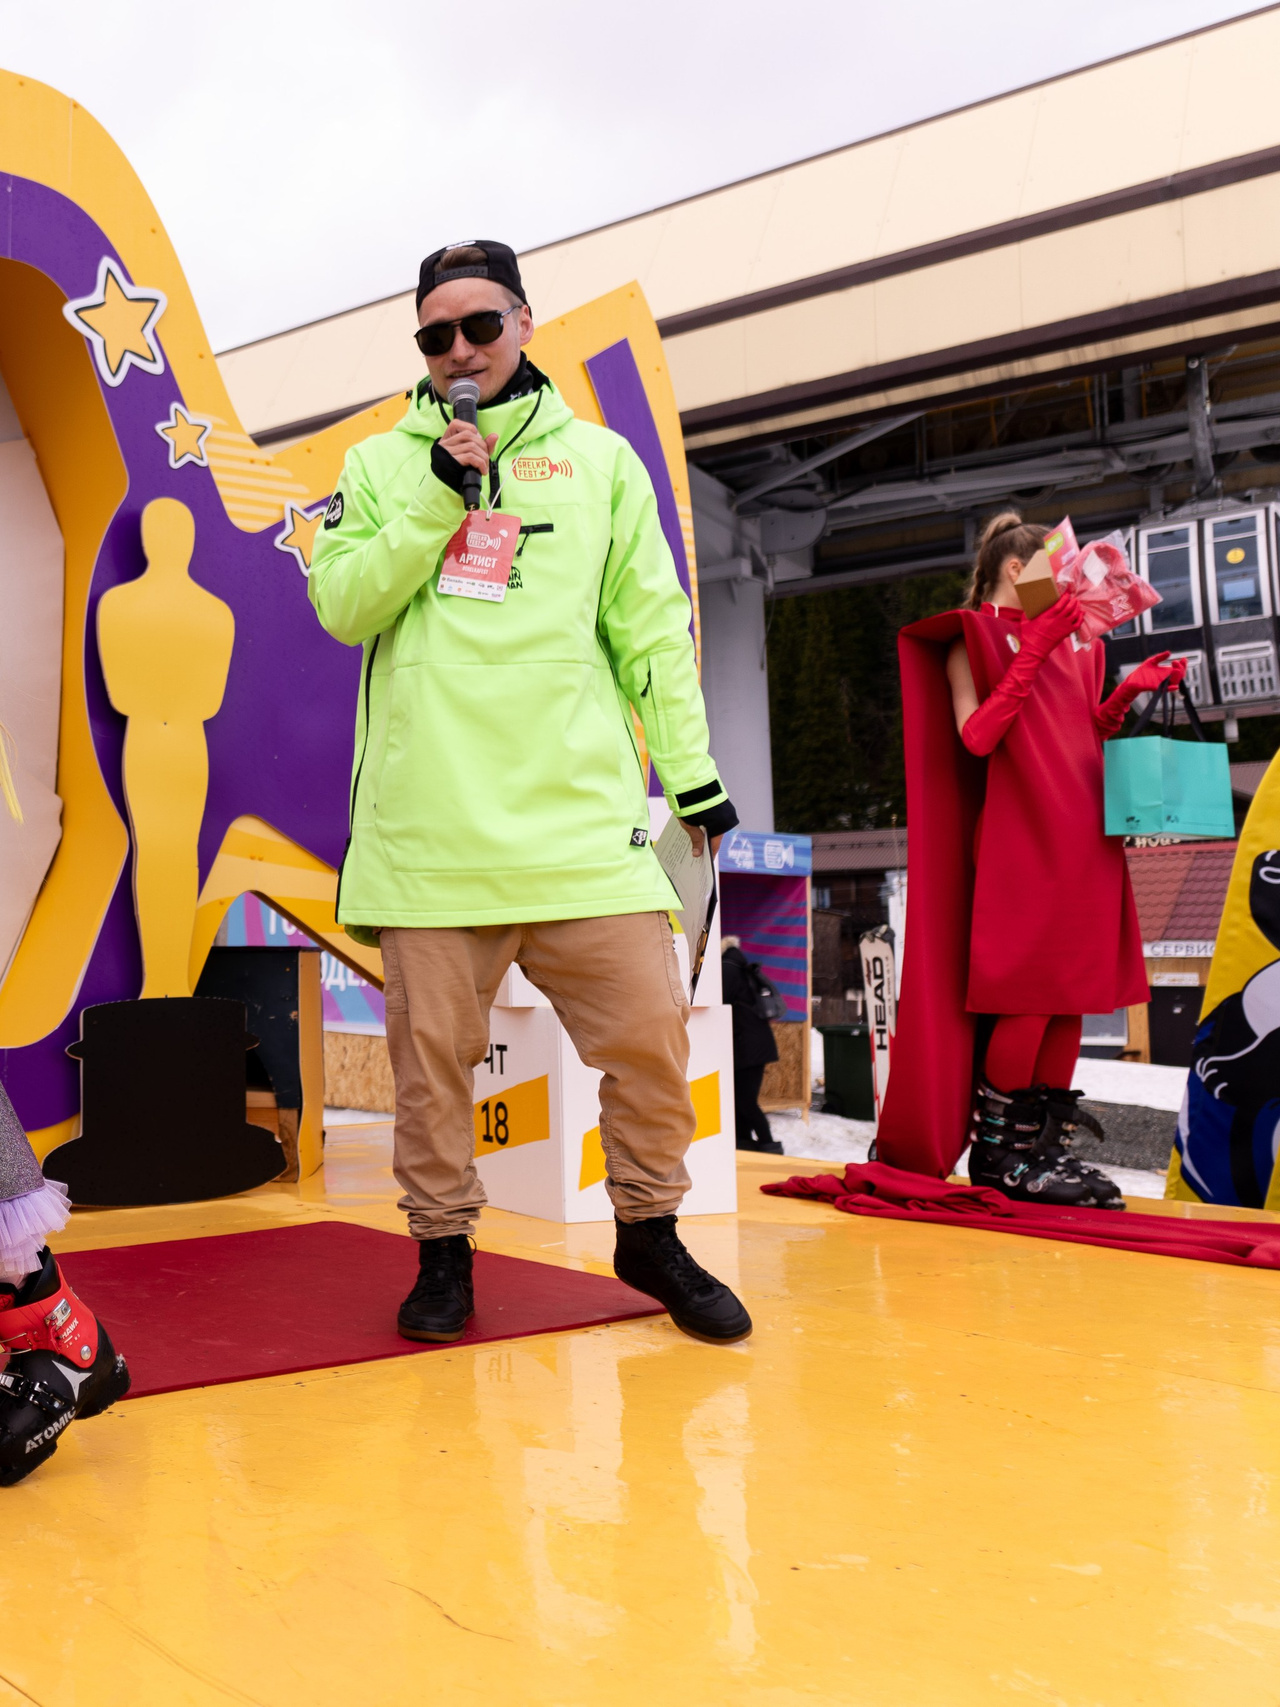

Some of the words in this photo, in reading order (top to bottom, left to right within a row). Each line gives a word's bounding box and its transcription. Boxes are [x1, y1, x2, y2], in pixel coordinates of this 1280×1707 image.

[517, 460, 547, 469] GRELKA
[518, 470, 537, 478] FEST
[459, 553, 498, 569] АРТИСТ
[872, 956, 888, 1051] HEAD
[481, 1100, 509, 1146] 18
[25, 1406, 78, 1454] ATOMIC
